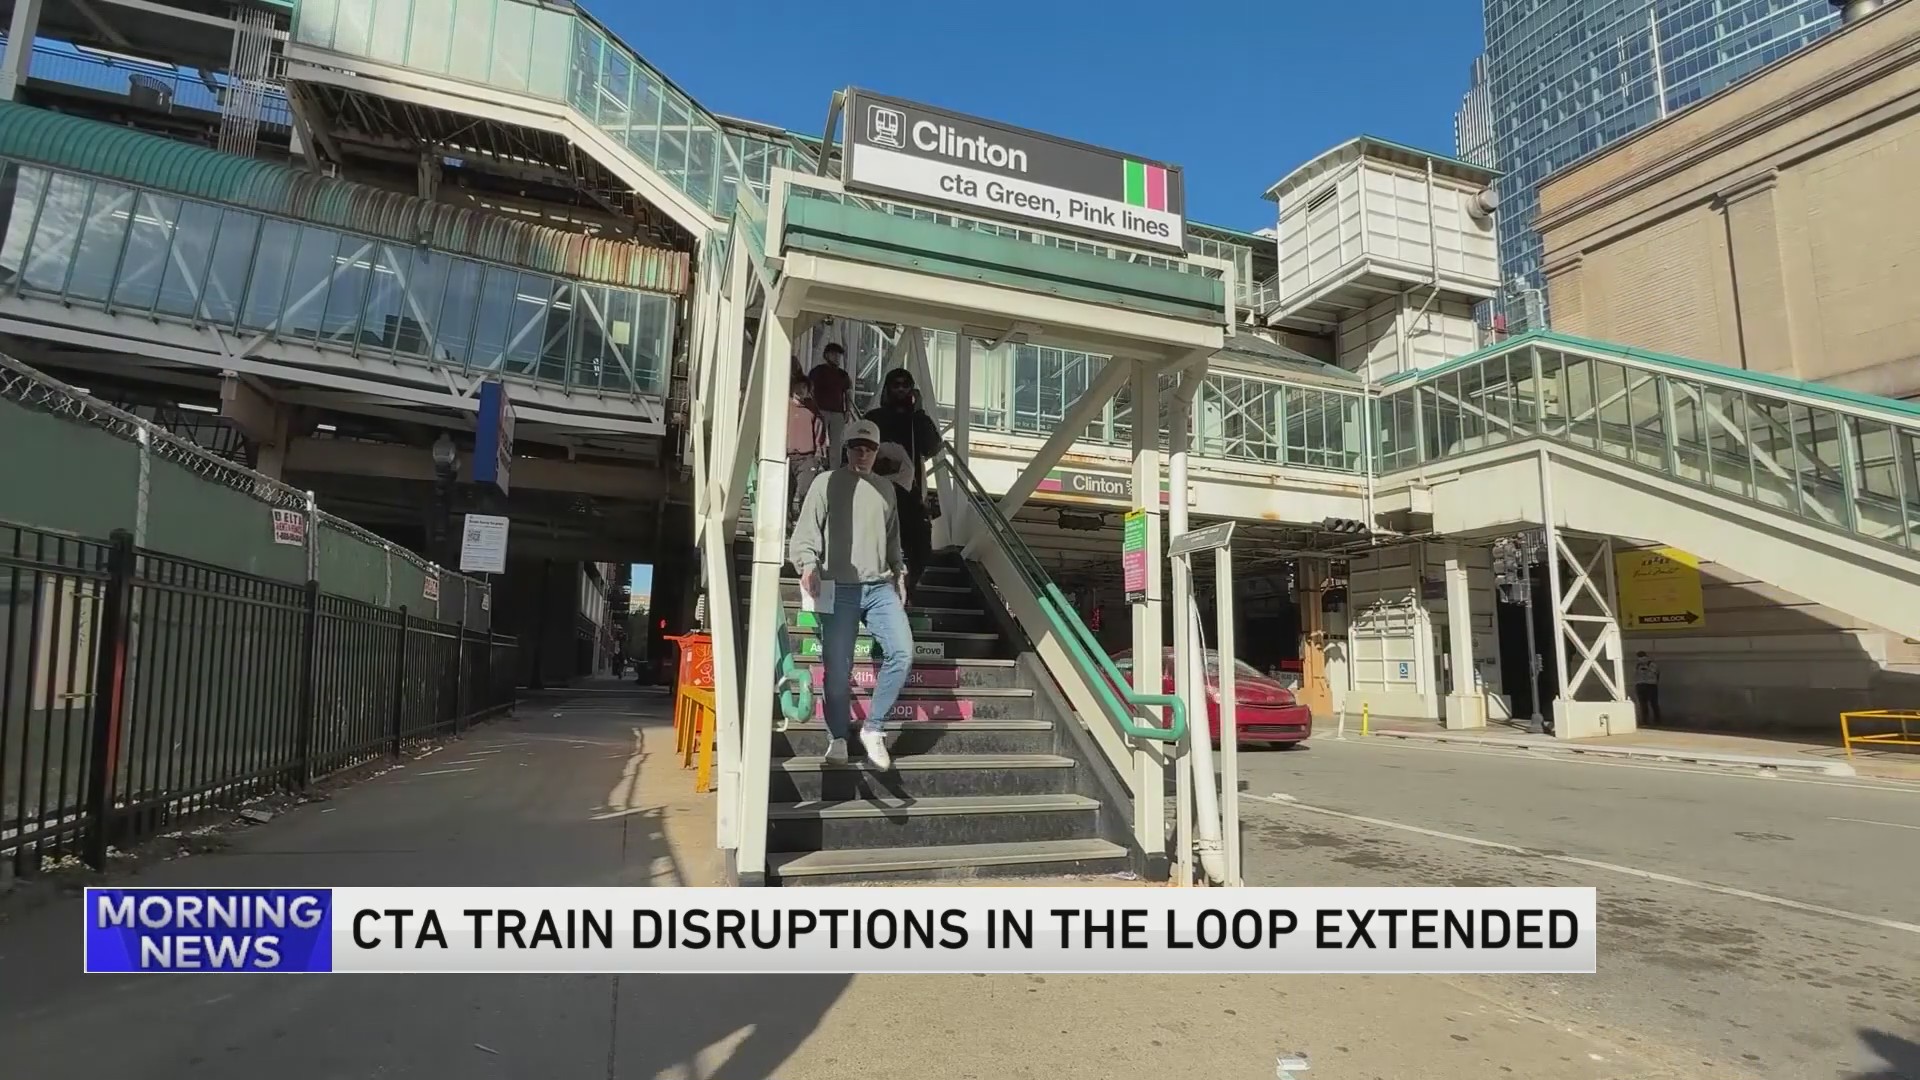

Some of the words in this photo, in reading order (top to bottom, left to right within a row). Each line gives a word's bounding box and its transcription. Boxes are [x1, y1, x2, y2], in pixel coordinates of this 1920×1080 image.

[913, 120, 1028, 173] Clinton
[939, 173, 978, 198] cta
[985, 181, 1061, 220] Green,
[1068, 198, 1115, 227] Pink
[1121, 210, 1170, 237] lines
[1073, 474, 1124, 495] Clinton
[915, 645, 941, 655] Grove
